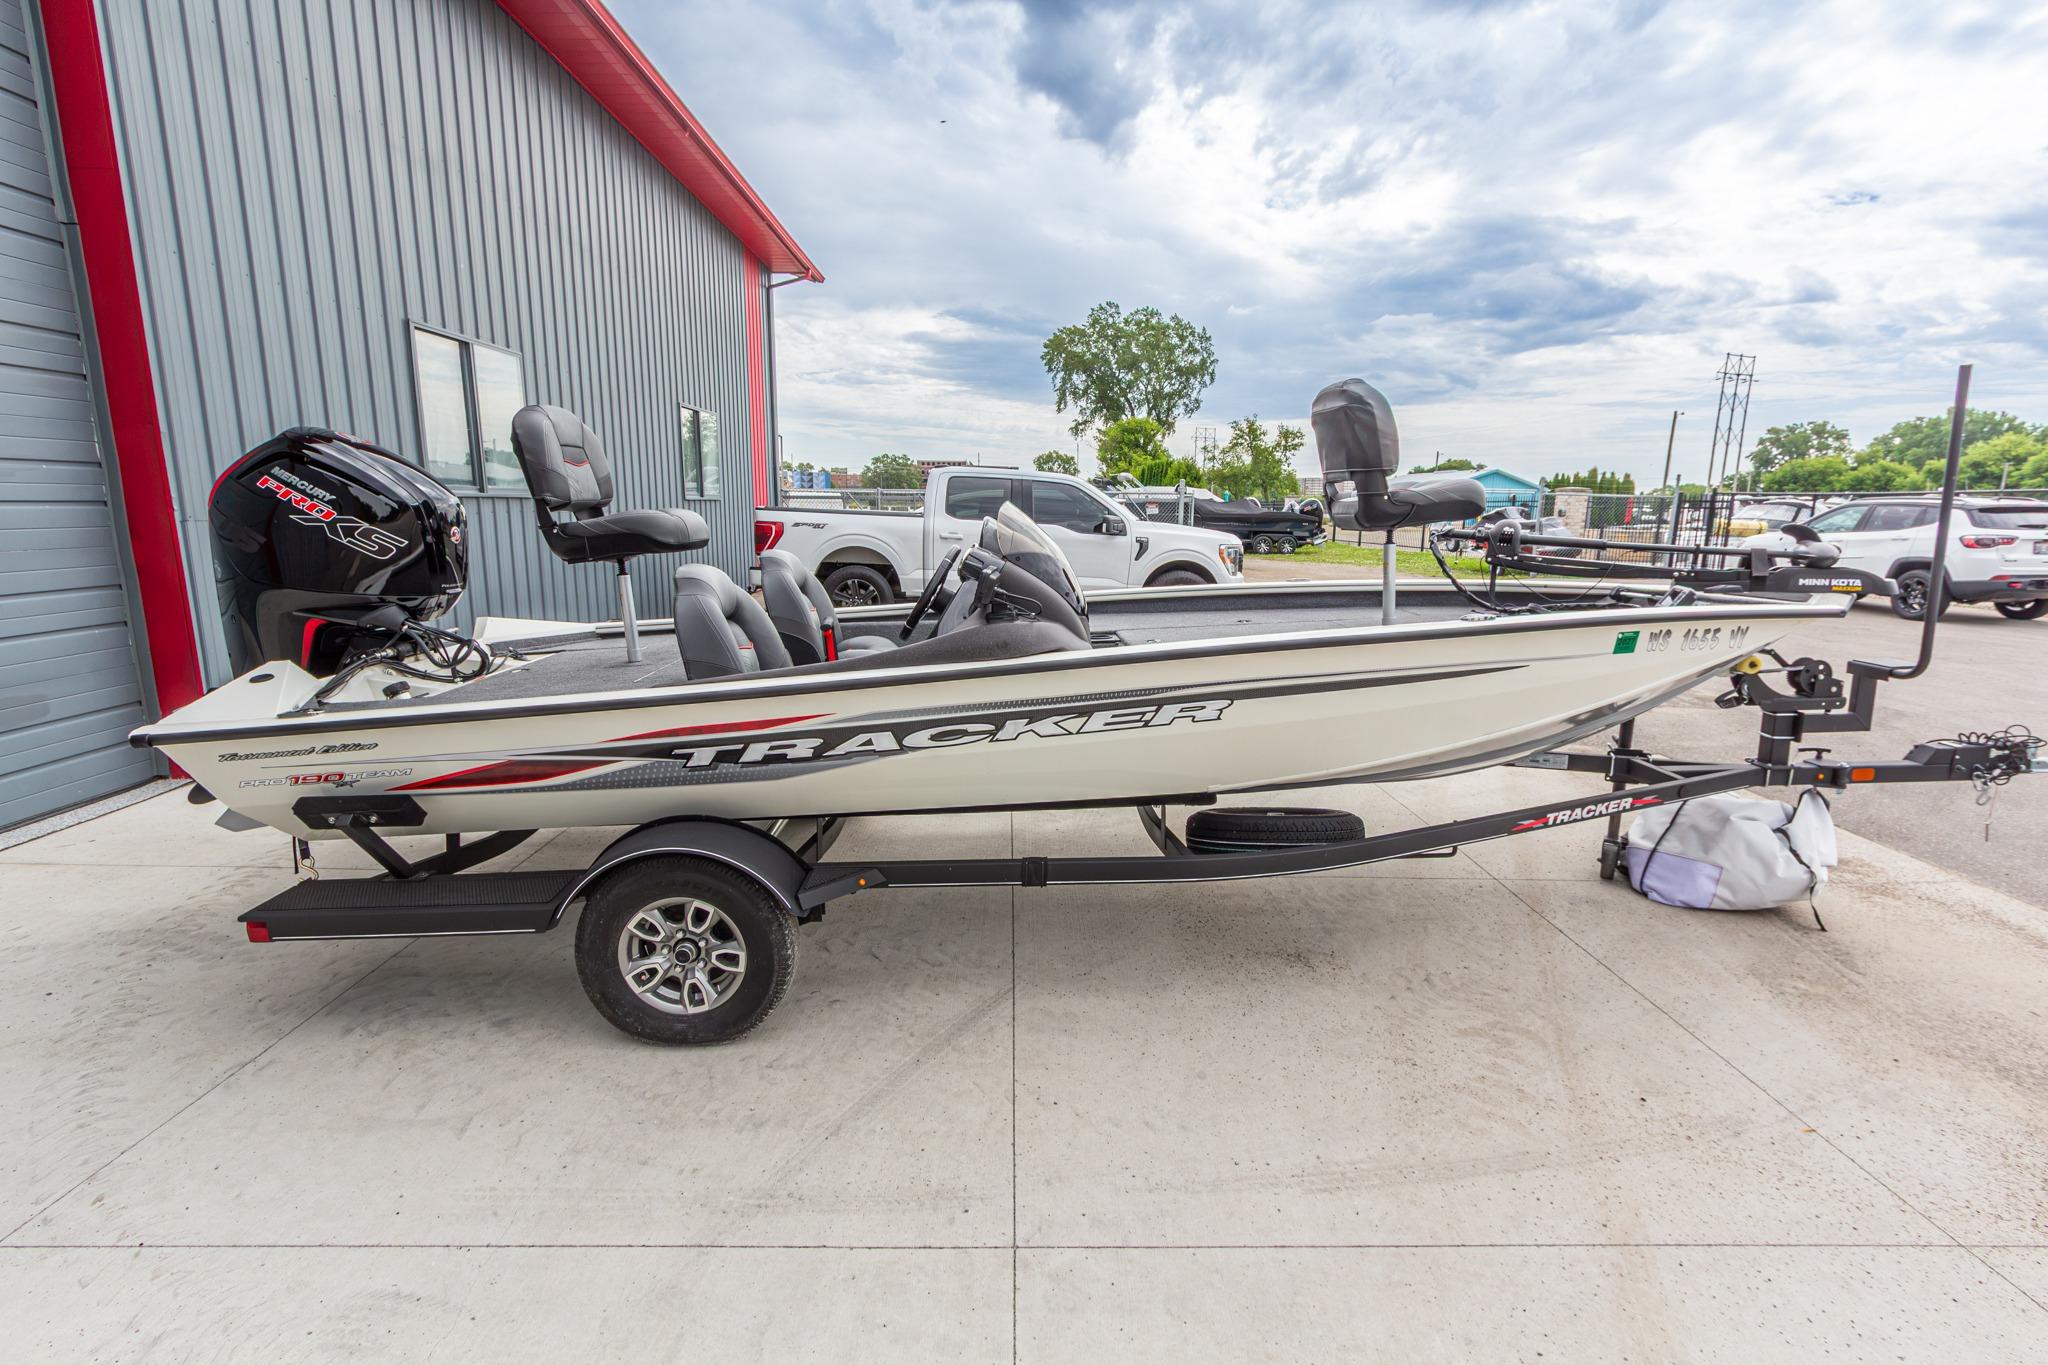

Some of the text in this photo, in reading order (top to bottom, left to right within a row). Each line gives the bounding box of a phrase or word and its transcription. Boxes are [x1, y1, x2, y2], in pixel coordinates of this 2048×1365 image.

[256, 475, 337, 522] PRO
[270, 466, 337, 502] MERCURY
[289, 515, 409, 560] XS
[1798, 578, 1862, 586] MINN KOTA
[1646, 628, 1673, 652] WS
[672, 699, 1234, 769] TRACKER
[218, 742, 379, 762] Tournament Edition
[1546, 797, 1633, 826] TRACKER
